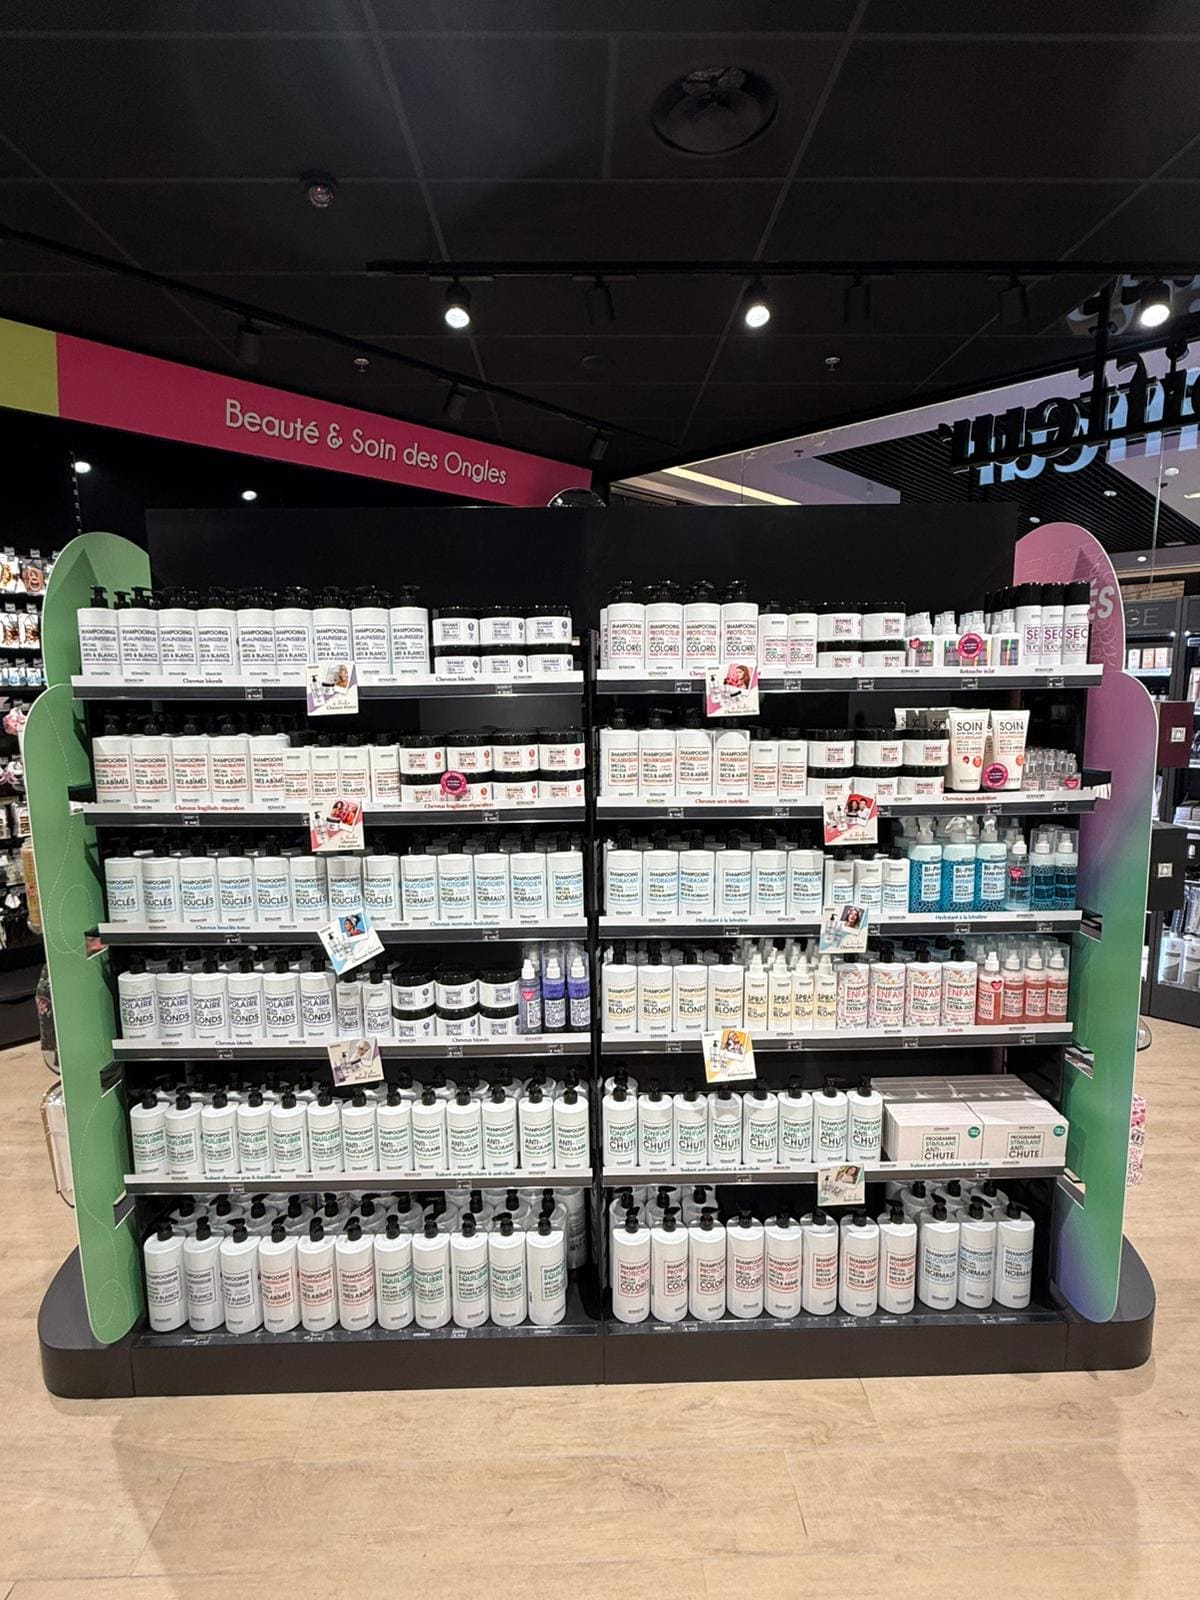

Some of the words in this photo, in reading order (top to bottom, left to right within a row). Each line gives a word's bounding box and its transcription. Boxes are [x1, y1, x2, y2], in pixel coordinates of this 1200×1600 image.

[225, 398, 320, 445] Beauté
[326, 423, 344, 449] &
[351, 428, 398, 462] Soin
[403, 443, 438, 470] des
[444, 452, 507, 485] Ongles
[1066, 629, 1088, 639] SEC
[957, 722, 982, 731] SOIN
[1000, 722, 1024, 730] SOIN
[925, 1152, 955, 1160] CHUTE
